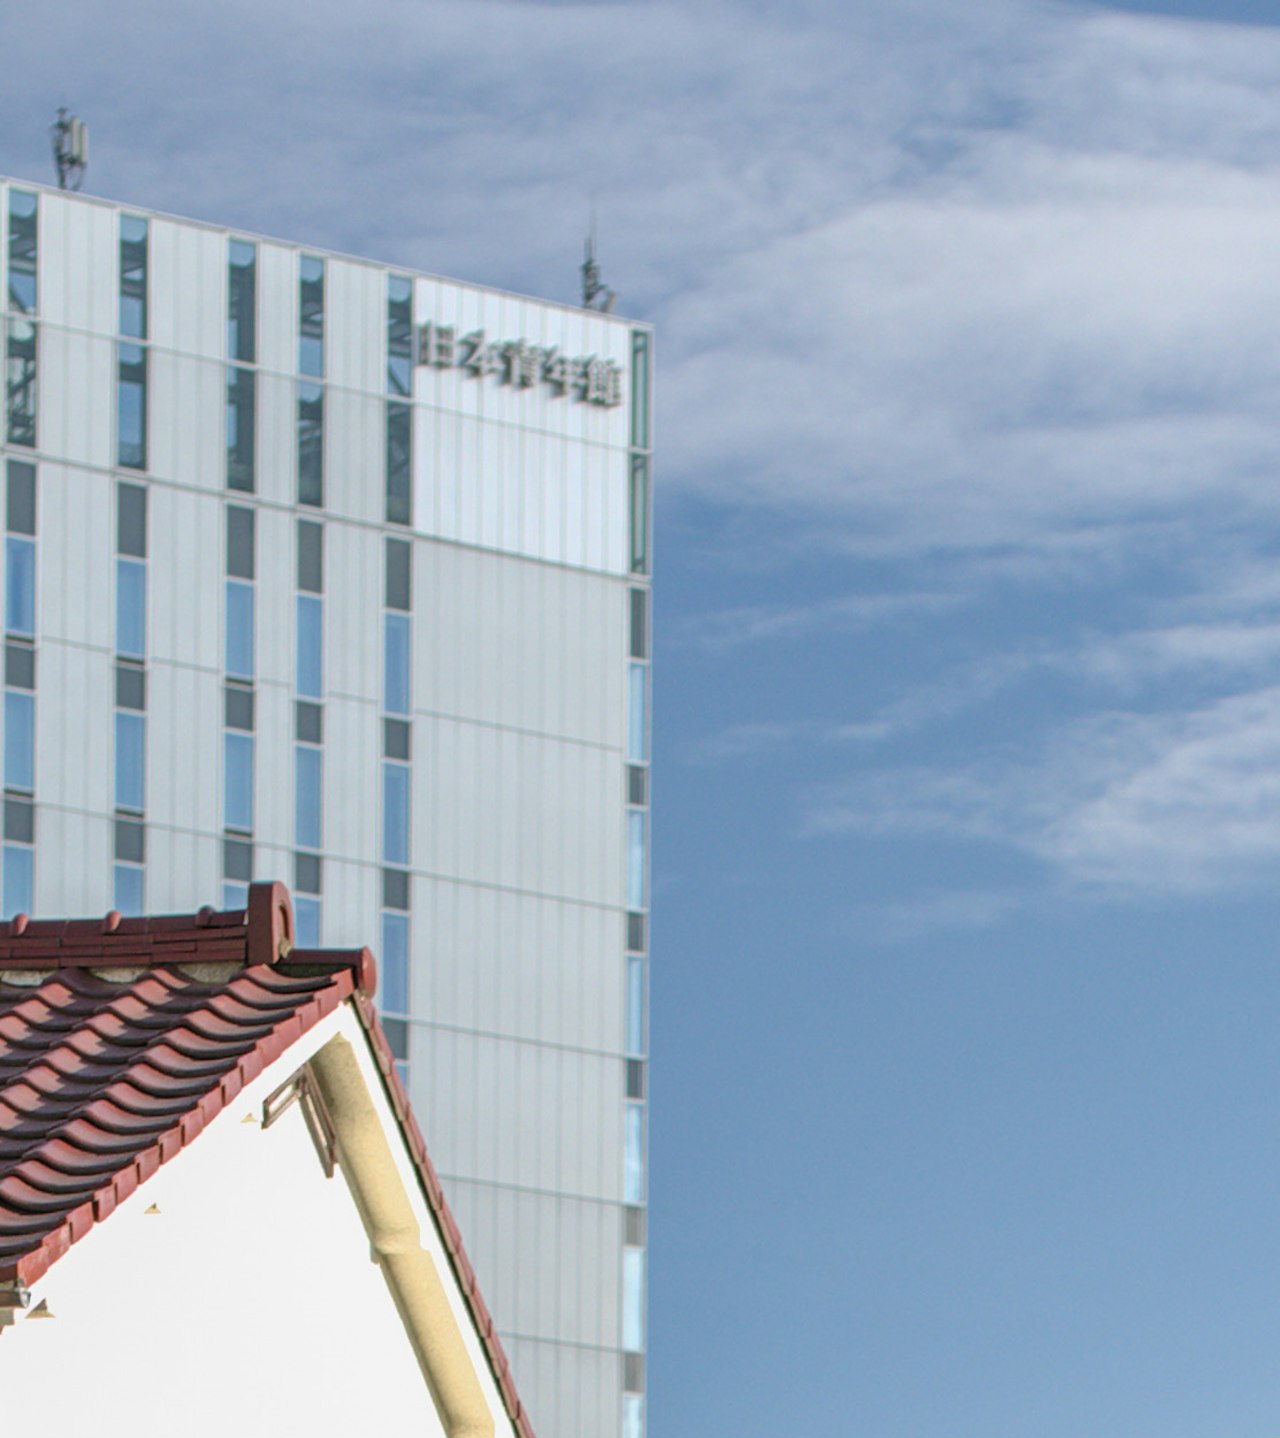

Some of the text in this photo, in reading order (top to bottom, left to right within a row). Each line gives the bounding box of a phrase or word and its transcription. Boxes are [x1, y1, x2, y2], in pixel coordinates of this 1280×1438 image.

[417, 321, 622, 407] 日本青年館
